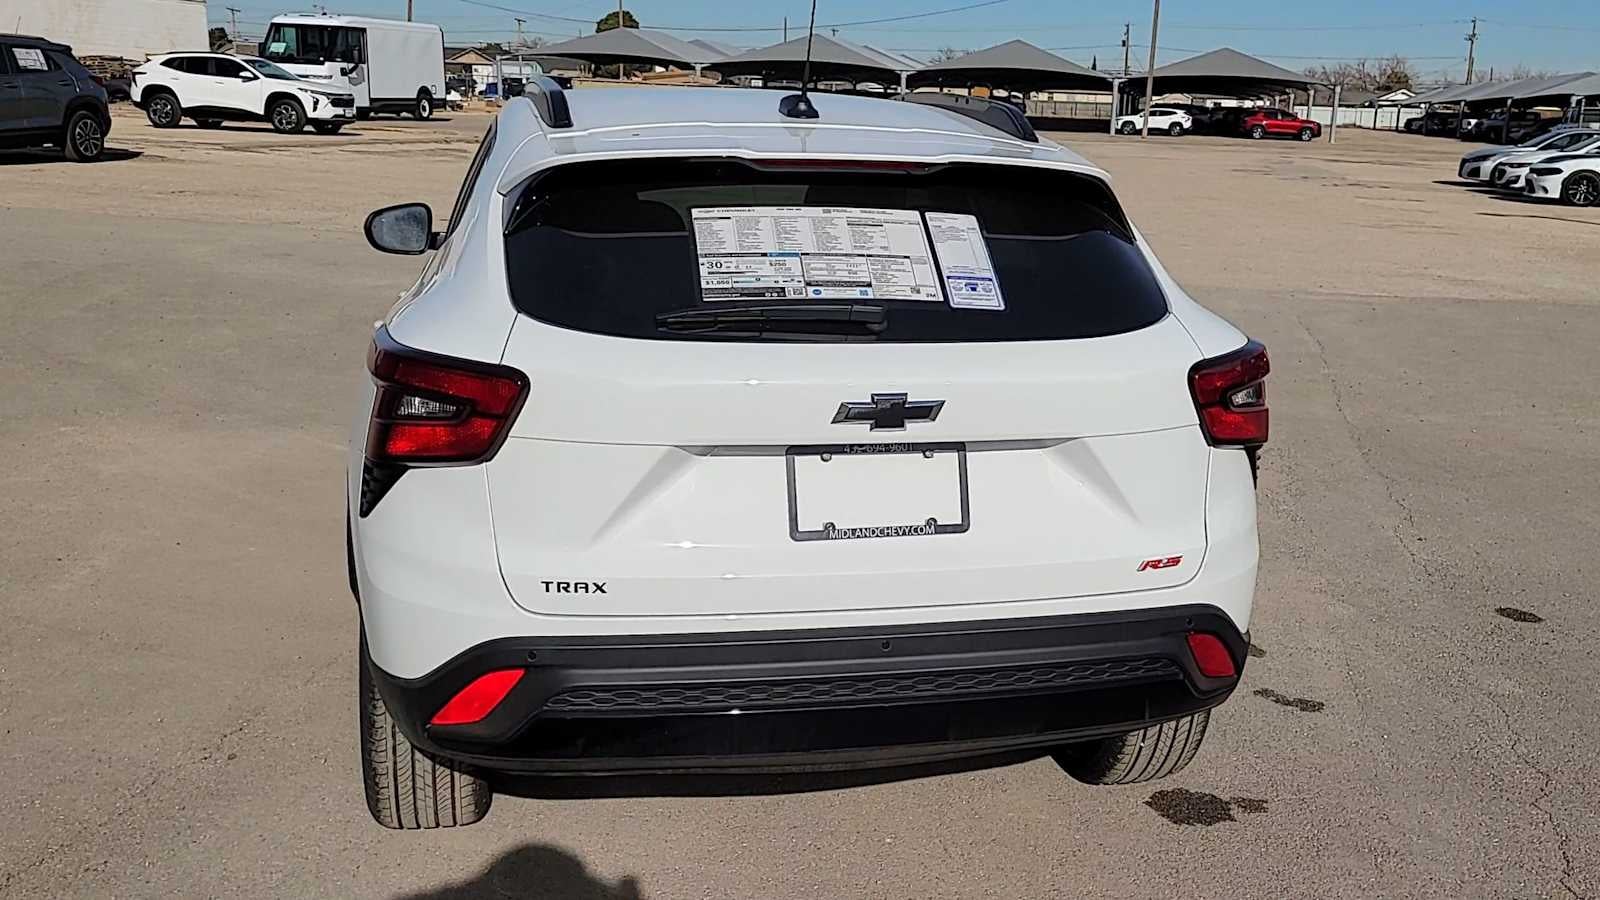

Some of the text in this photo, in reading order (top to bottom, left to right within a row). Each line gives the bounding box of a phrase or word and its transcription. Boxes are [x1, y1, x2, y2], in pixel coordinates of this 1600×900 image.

[706, 261, 723, 269] 30
[829, 525, 936, 540] MIDLANDCHEVY.COM
[1136, 555, 1183, 572] RS
[540, 581, 607, 593] TRAX
